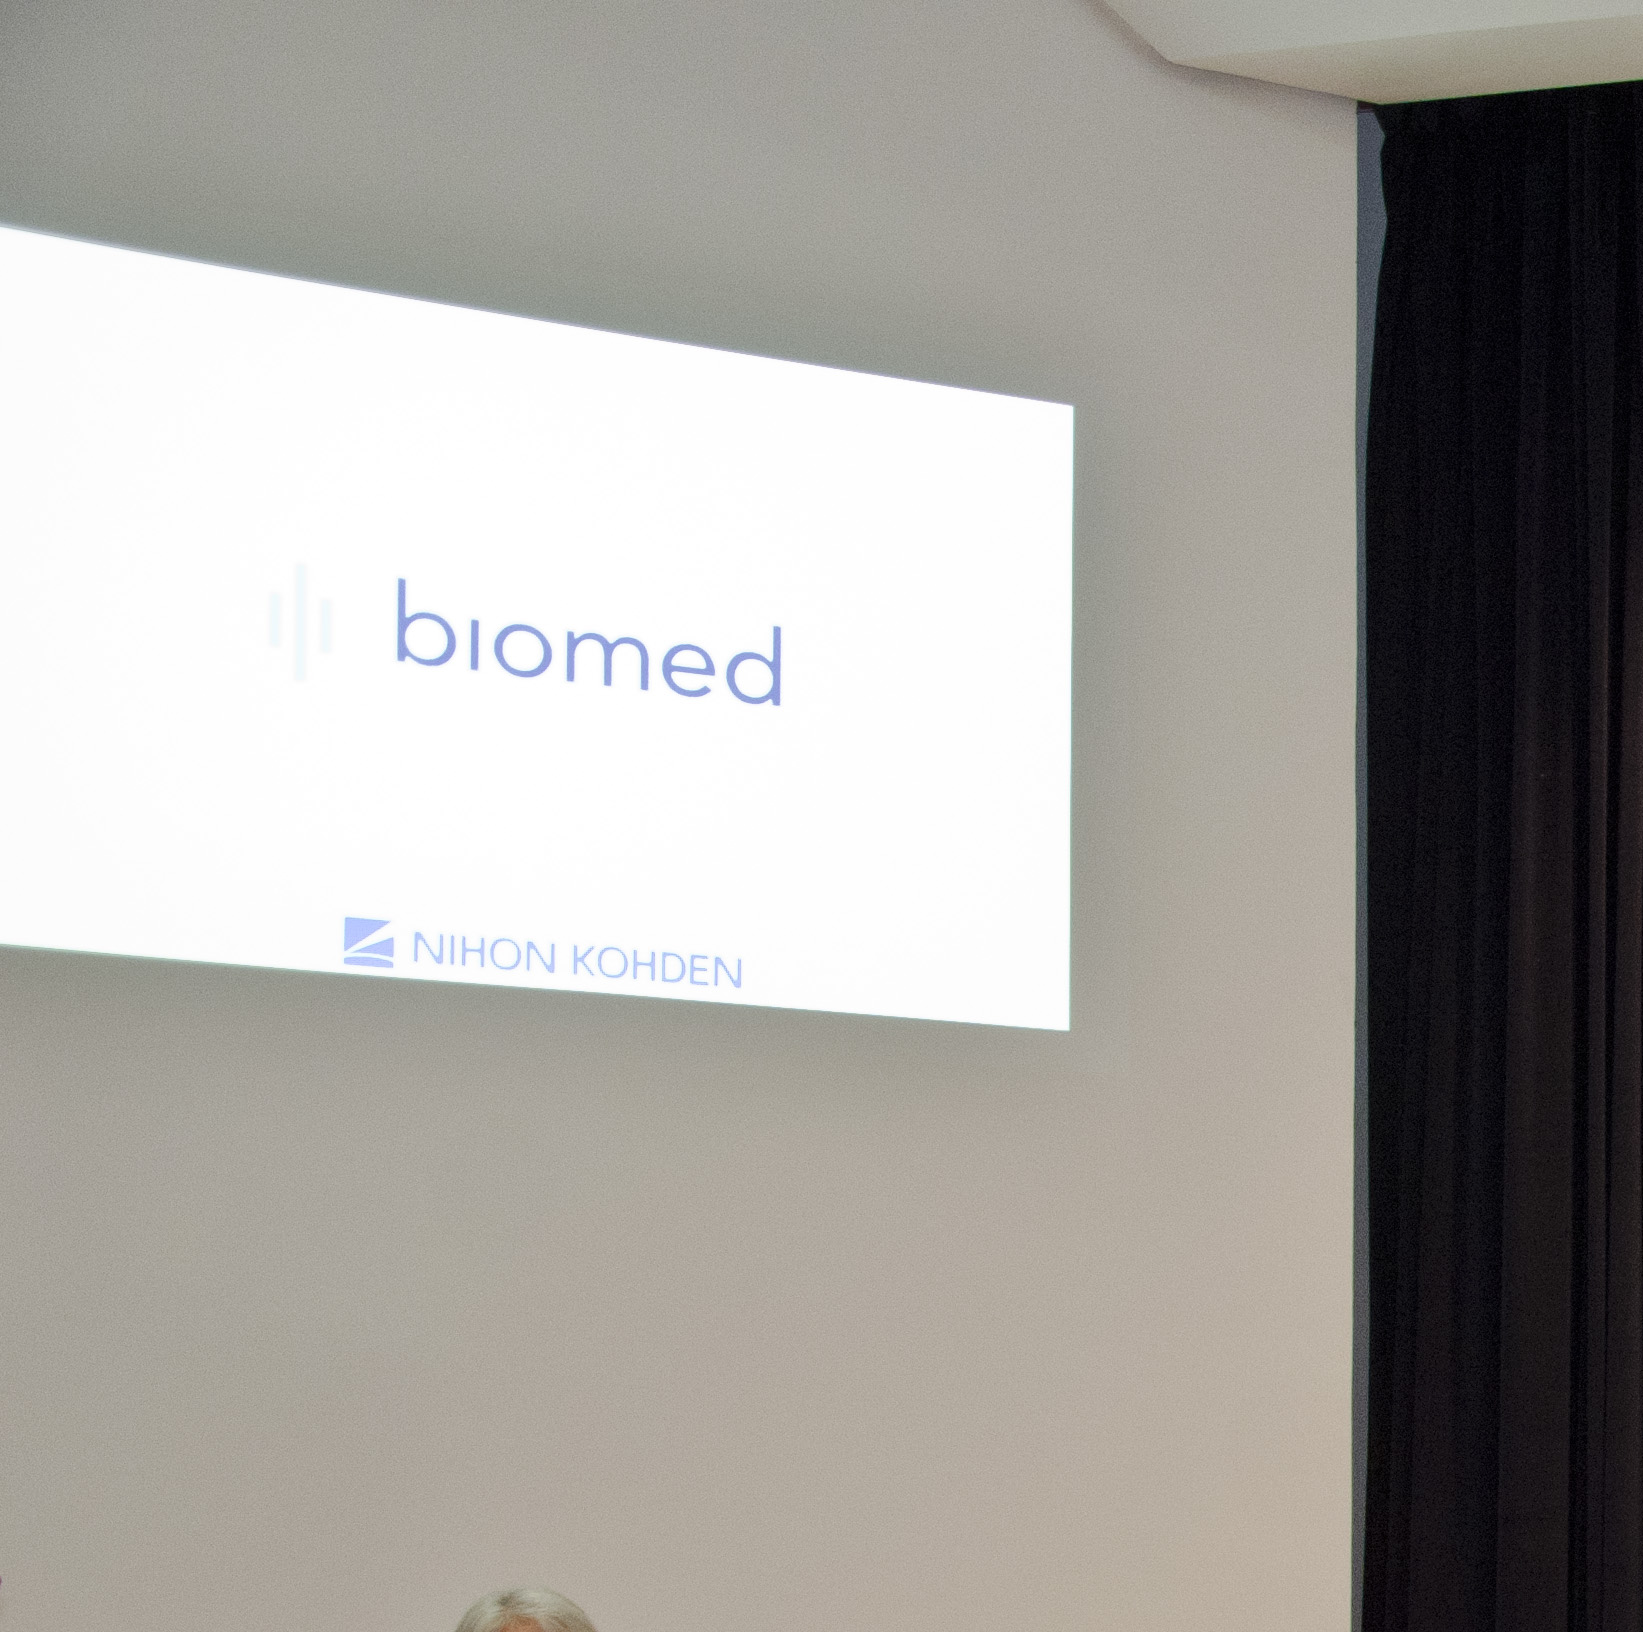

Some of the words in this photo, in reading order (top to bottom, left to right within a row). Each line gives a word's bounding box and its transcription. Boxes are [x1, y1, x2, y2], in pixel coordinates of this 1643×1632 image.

[397, 578, 781, 706] biomed
[414, 932, 555, 973] NIHON
[573, 945, 742, 988] KOHDEN
